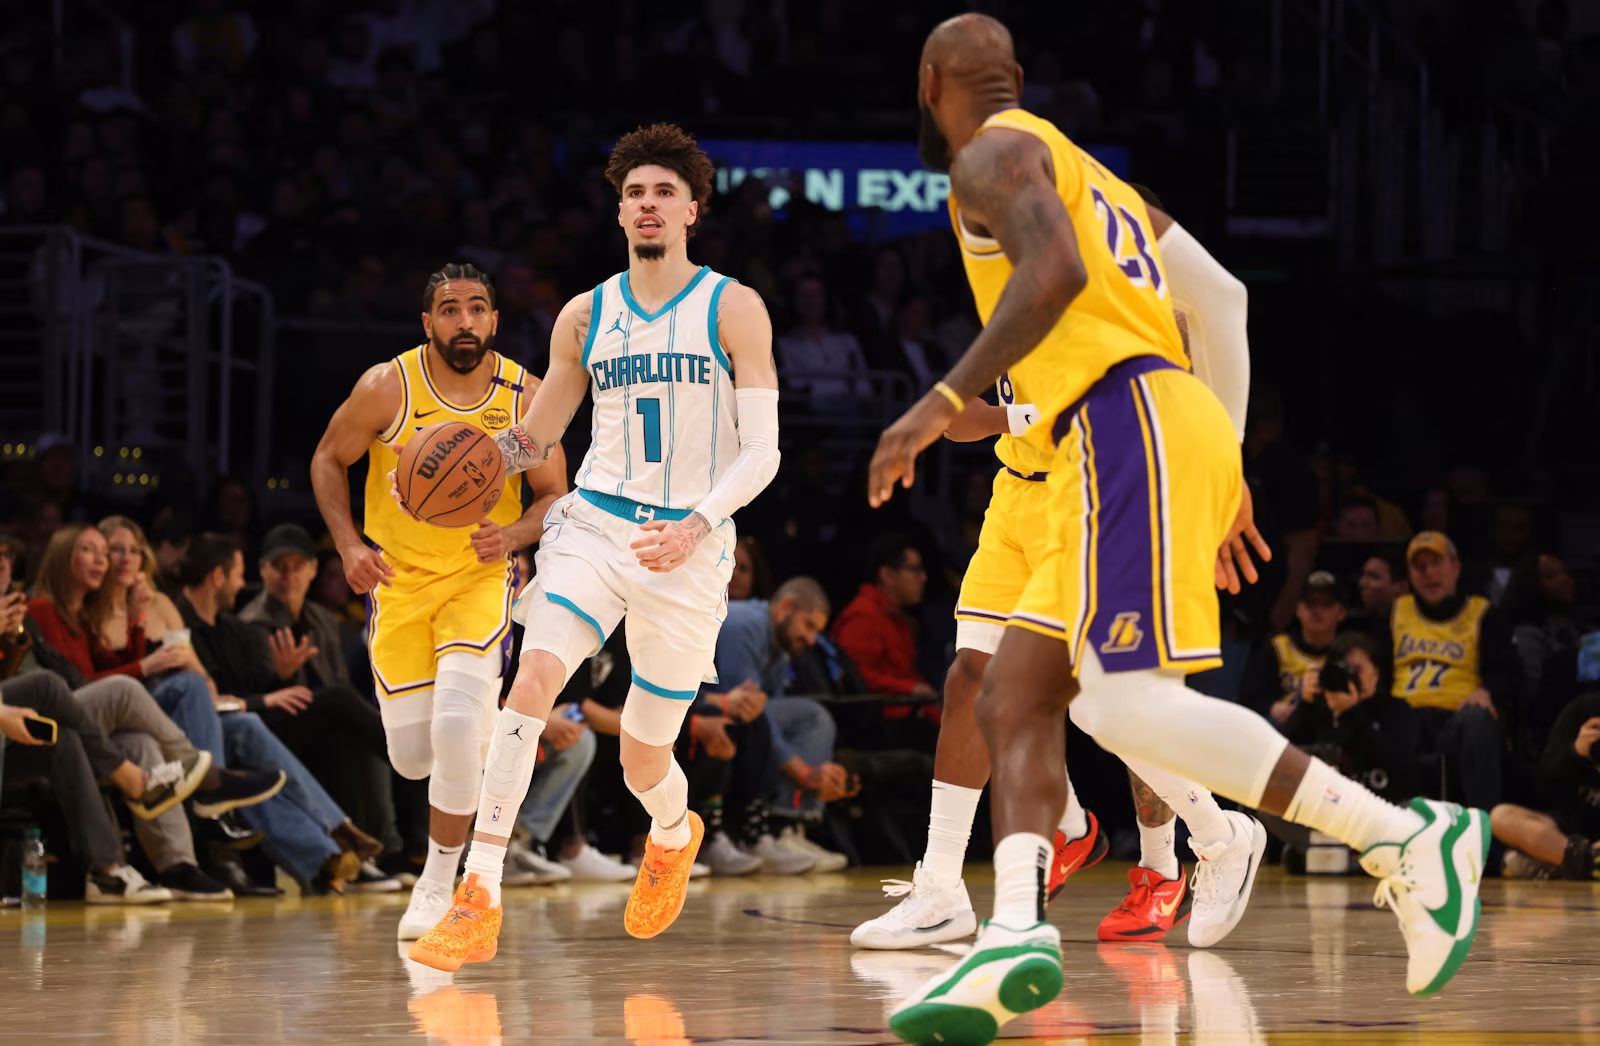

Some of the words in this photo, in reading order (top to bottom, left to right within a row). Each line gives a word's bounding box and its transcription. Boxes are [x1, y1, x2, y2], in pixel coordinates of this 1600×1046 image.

[591, 352, 710, 391] CHARLOTTE
[483, 413, 509, 424] bibigo
[636, 398, 661, 463] 1
[416, 427, 476, 480] Wilson
[1406, 659, 1451, 692] 77
